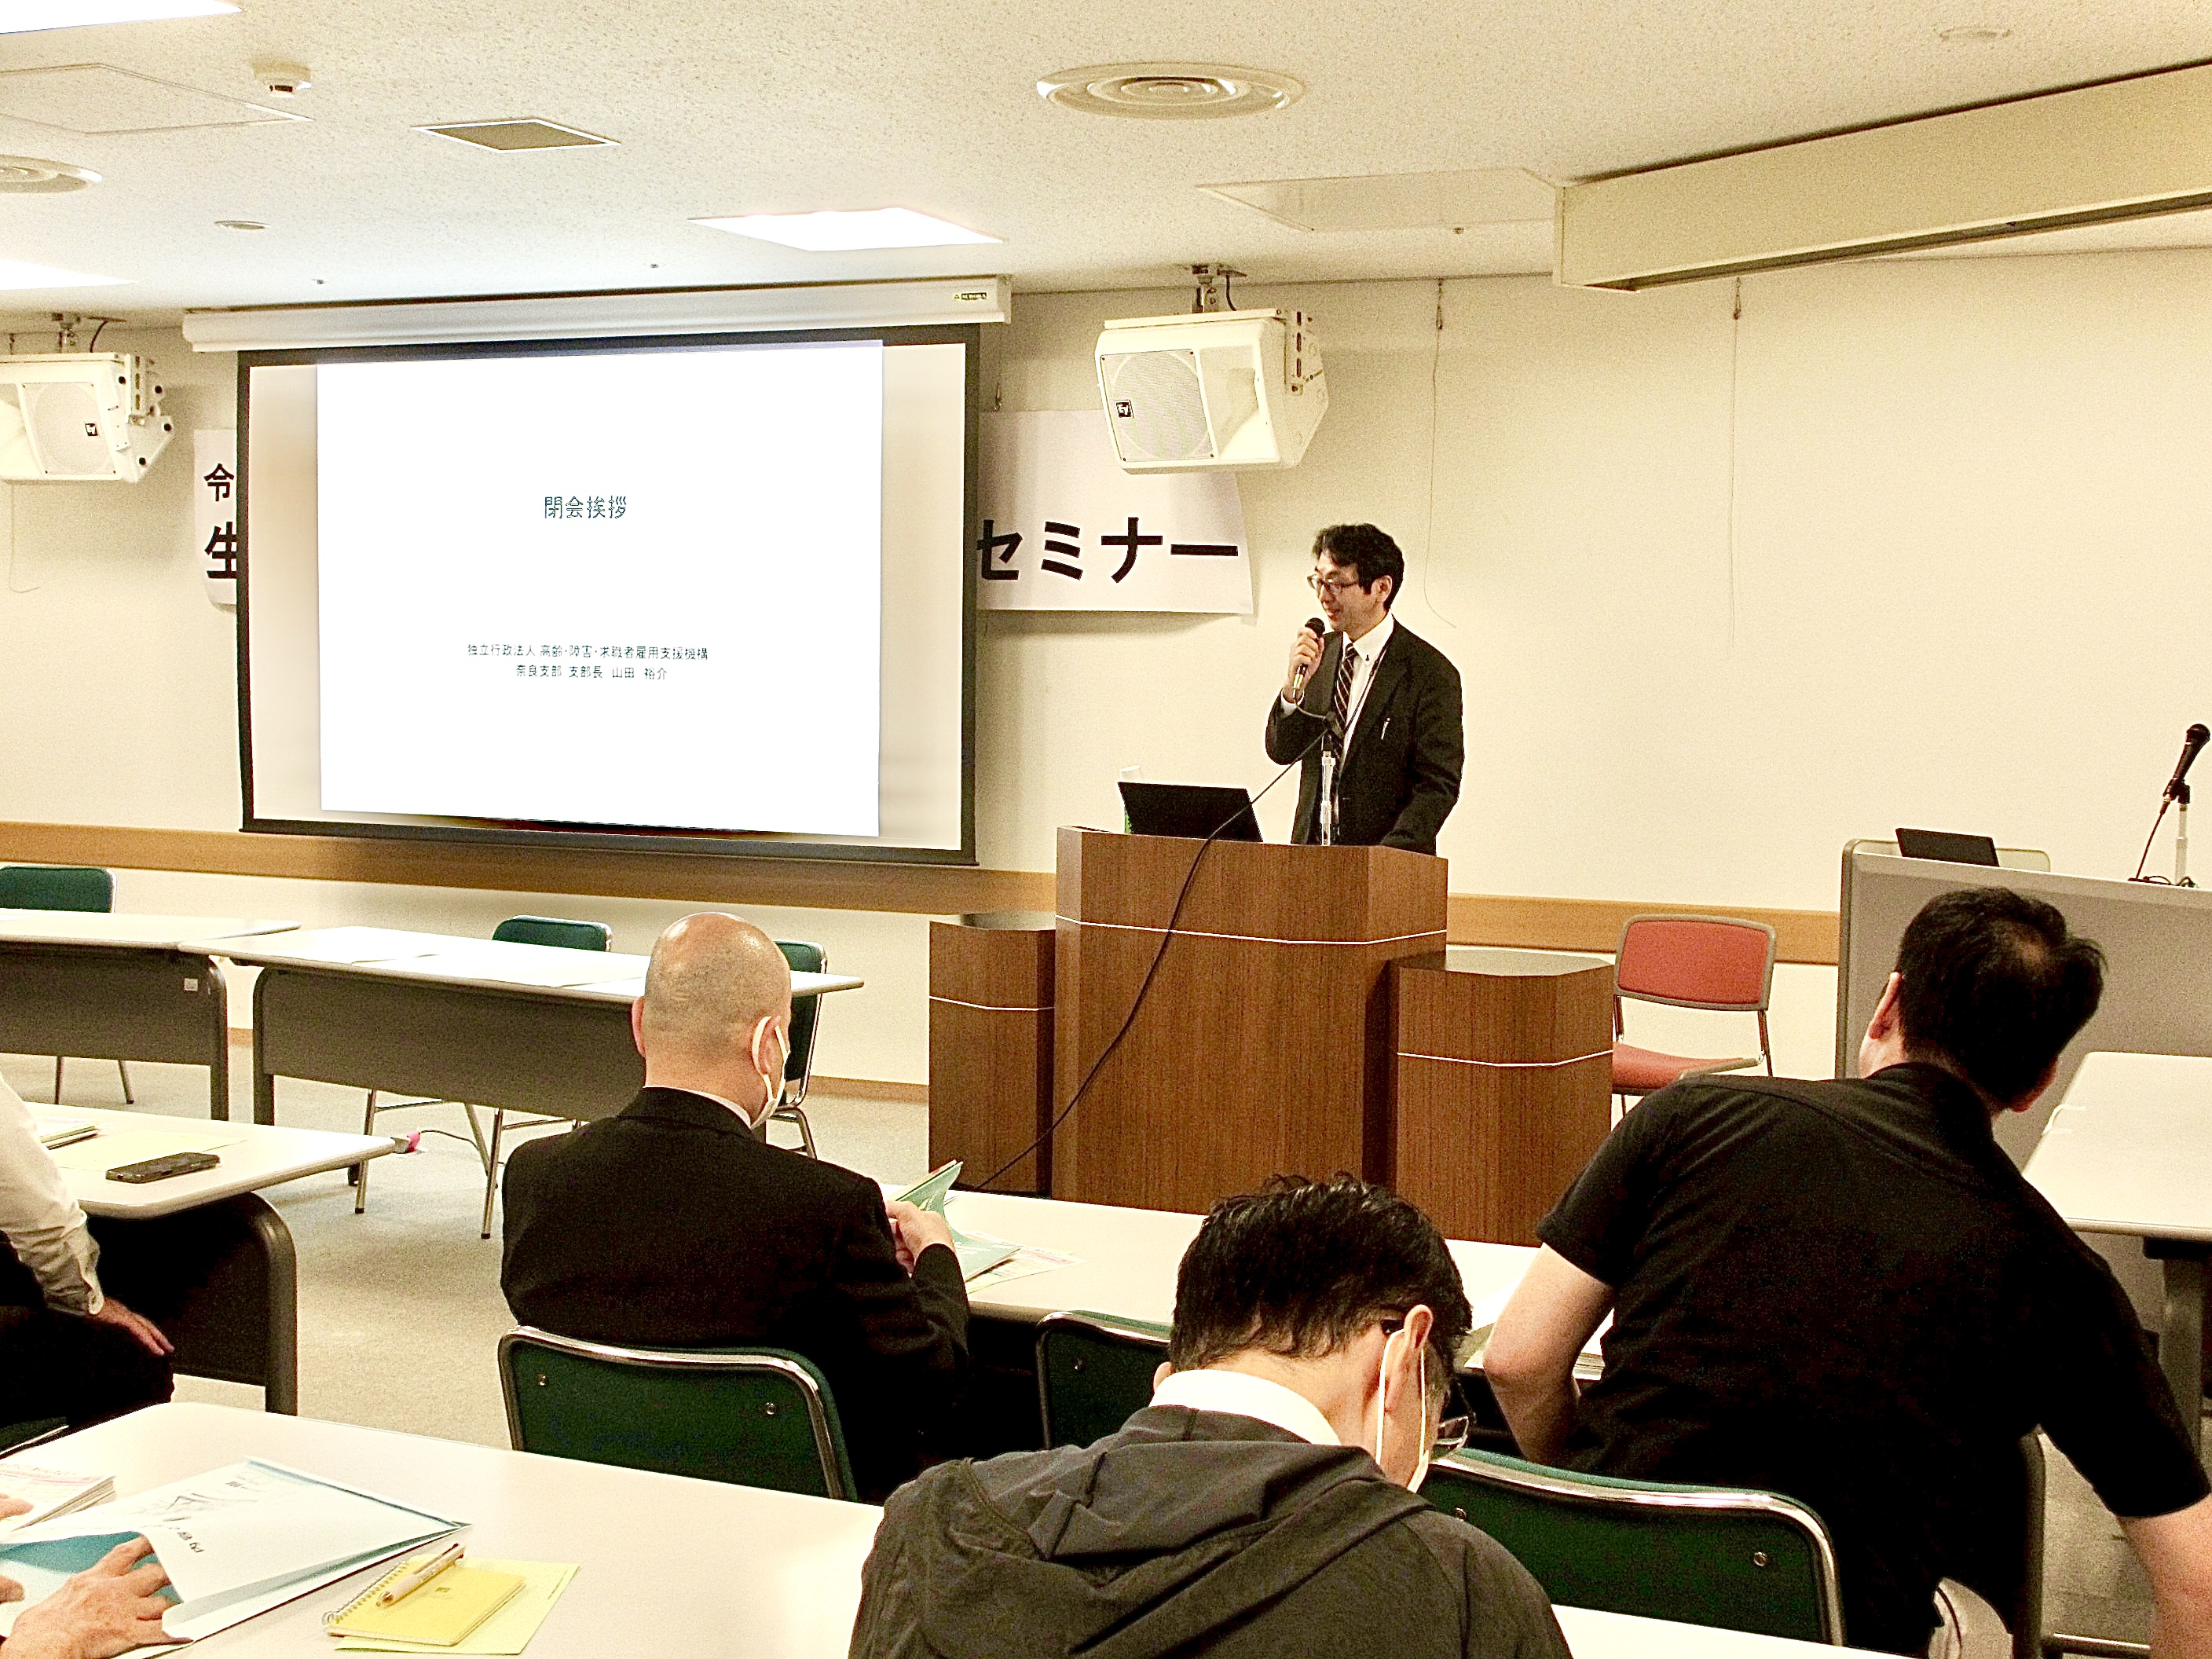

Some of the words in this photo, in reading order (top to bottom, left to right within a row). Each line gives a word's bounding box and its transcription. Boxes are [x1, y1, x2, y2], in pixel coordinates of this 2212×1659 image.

[203, 463, 235, 502] 令
[544, 495, 627, 519] 閉会挨拶
[976, 516, 1239, 584] セミナー
[467, 643, 536, 657] 独立行政法人
[515, 665, 562, 678] 奈良支部
[568, 665, 602, 679] 支部長
[612, 667, 635, 679] 山田
